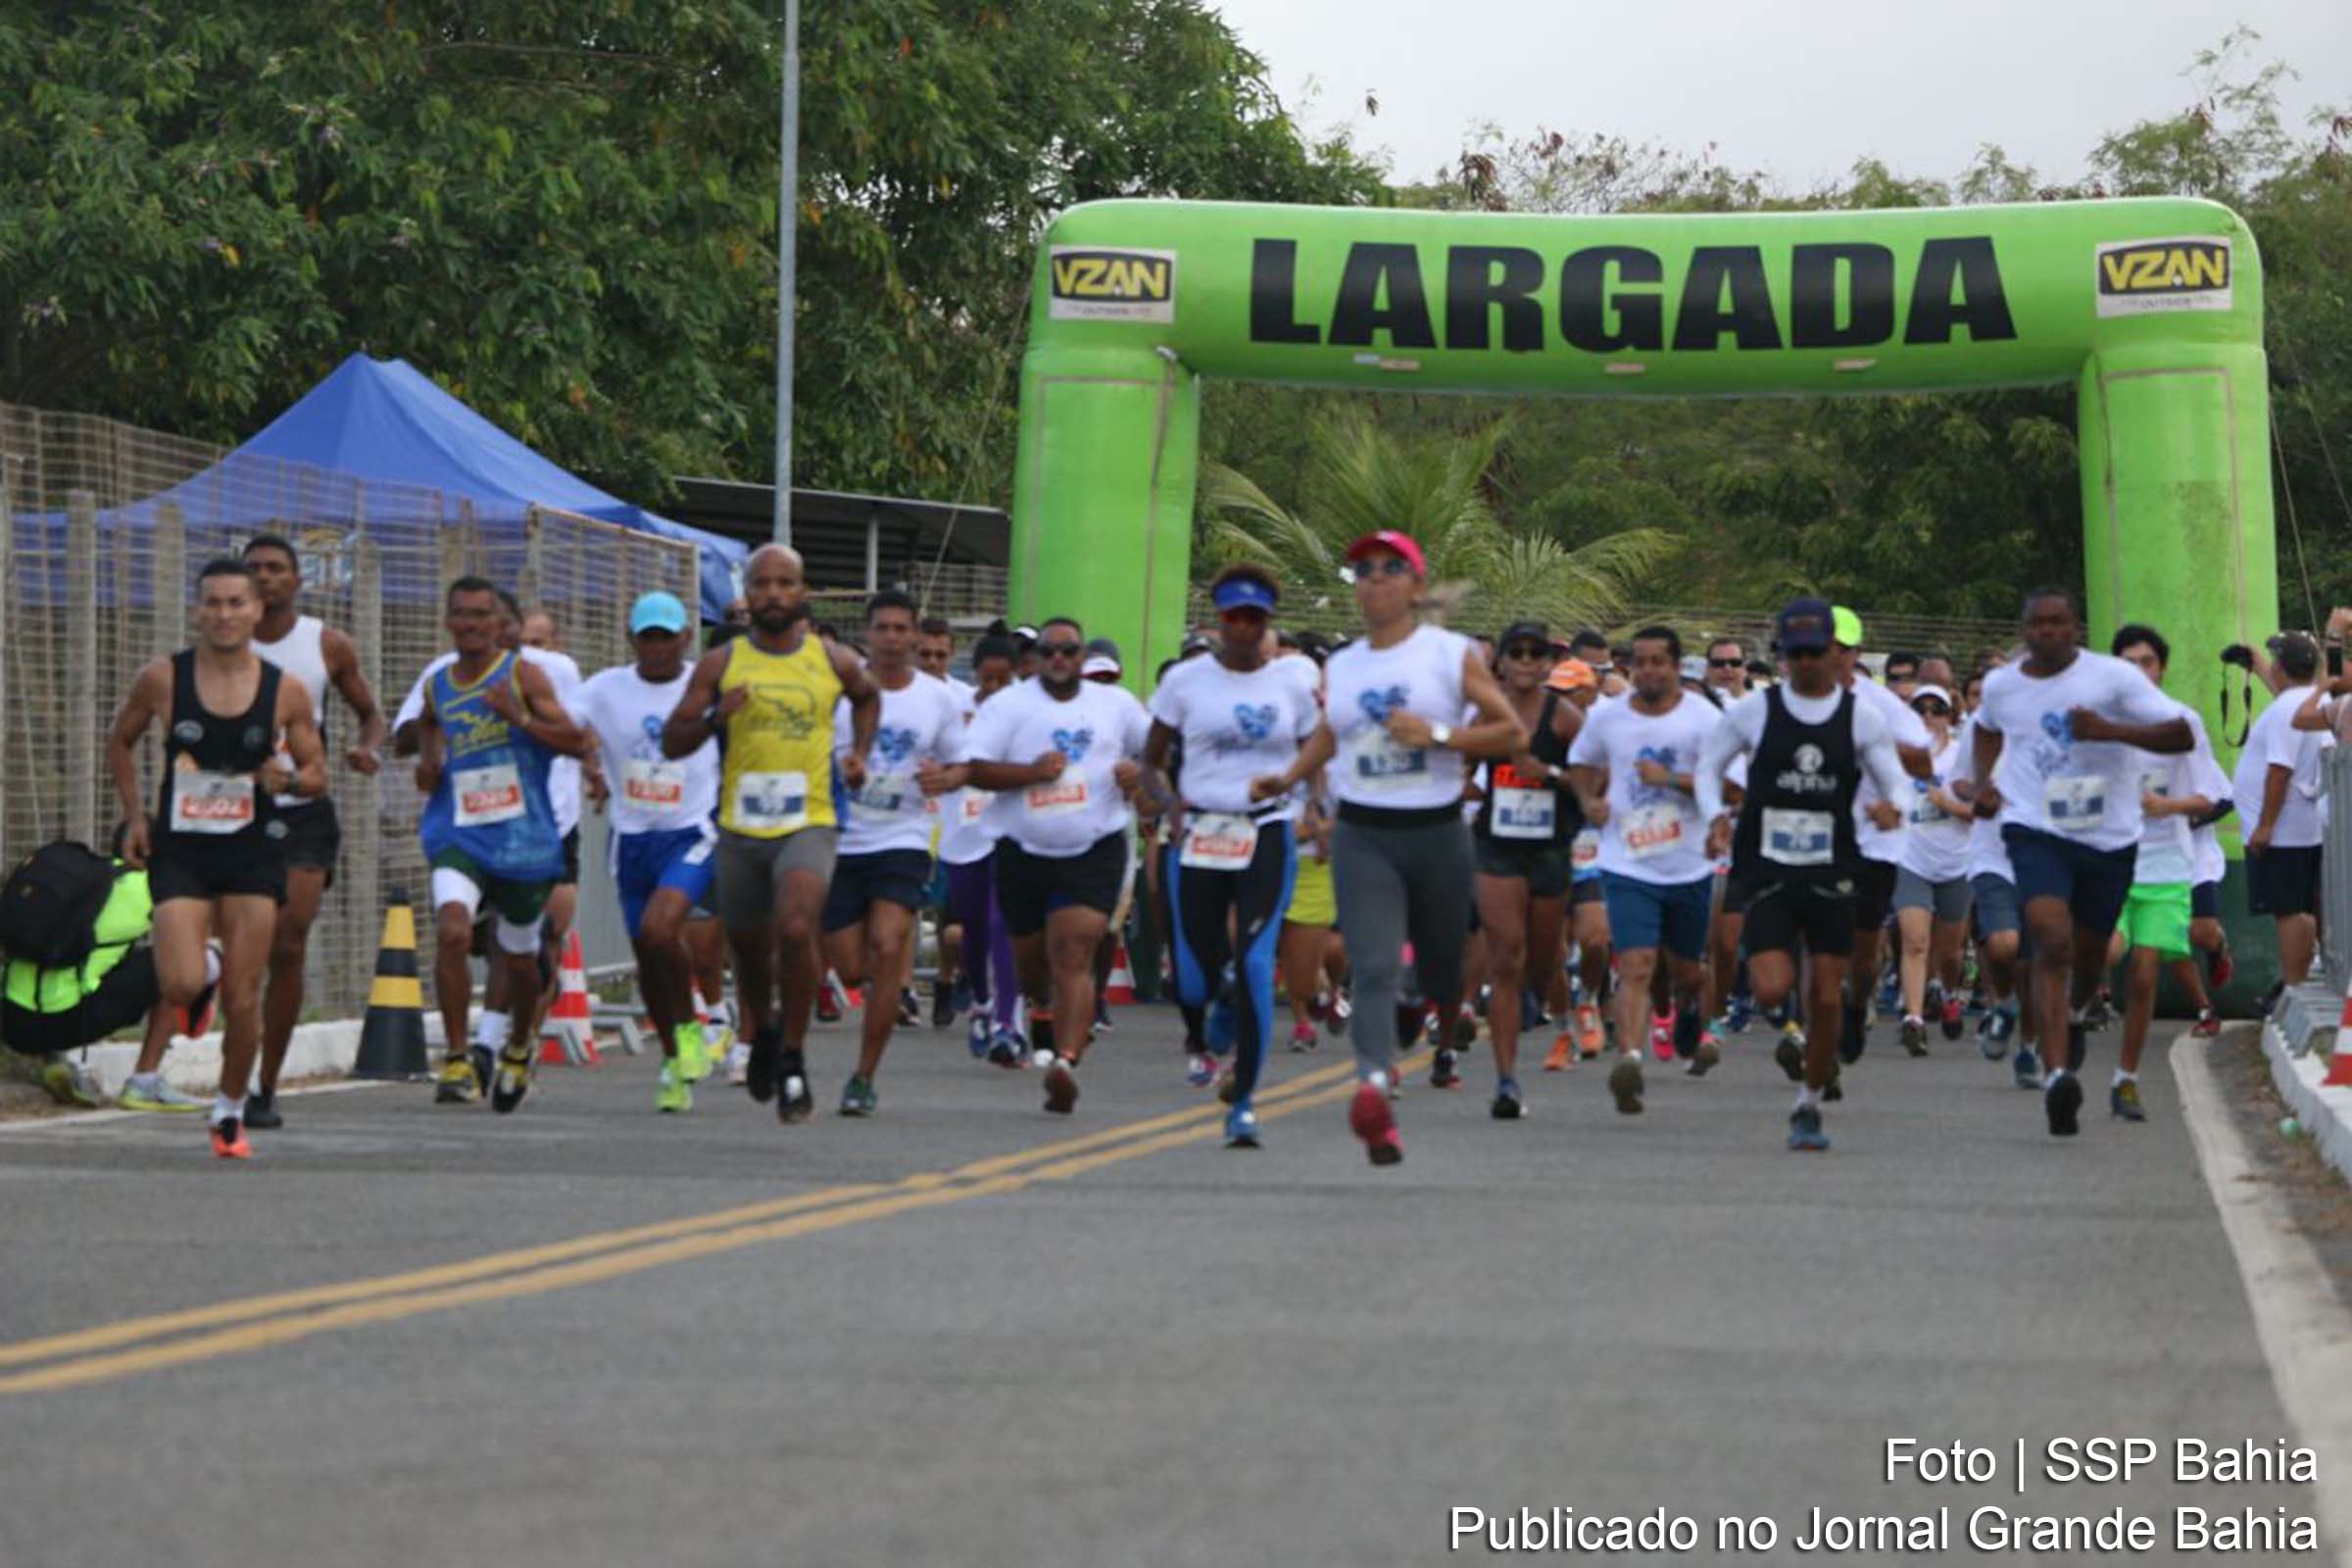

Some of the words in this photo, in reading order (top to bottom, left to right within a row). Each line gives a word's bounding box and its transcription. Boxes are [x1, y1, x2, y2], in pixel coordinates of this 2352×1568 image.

[1053, 258, 1166, 296] VZAN
[2102, 248, 2227, 290] VZAN
[1250, 237, 2018, 354] LARGADA
